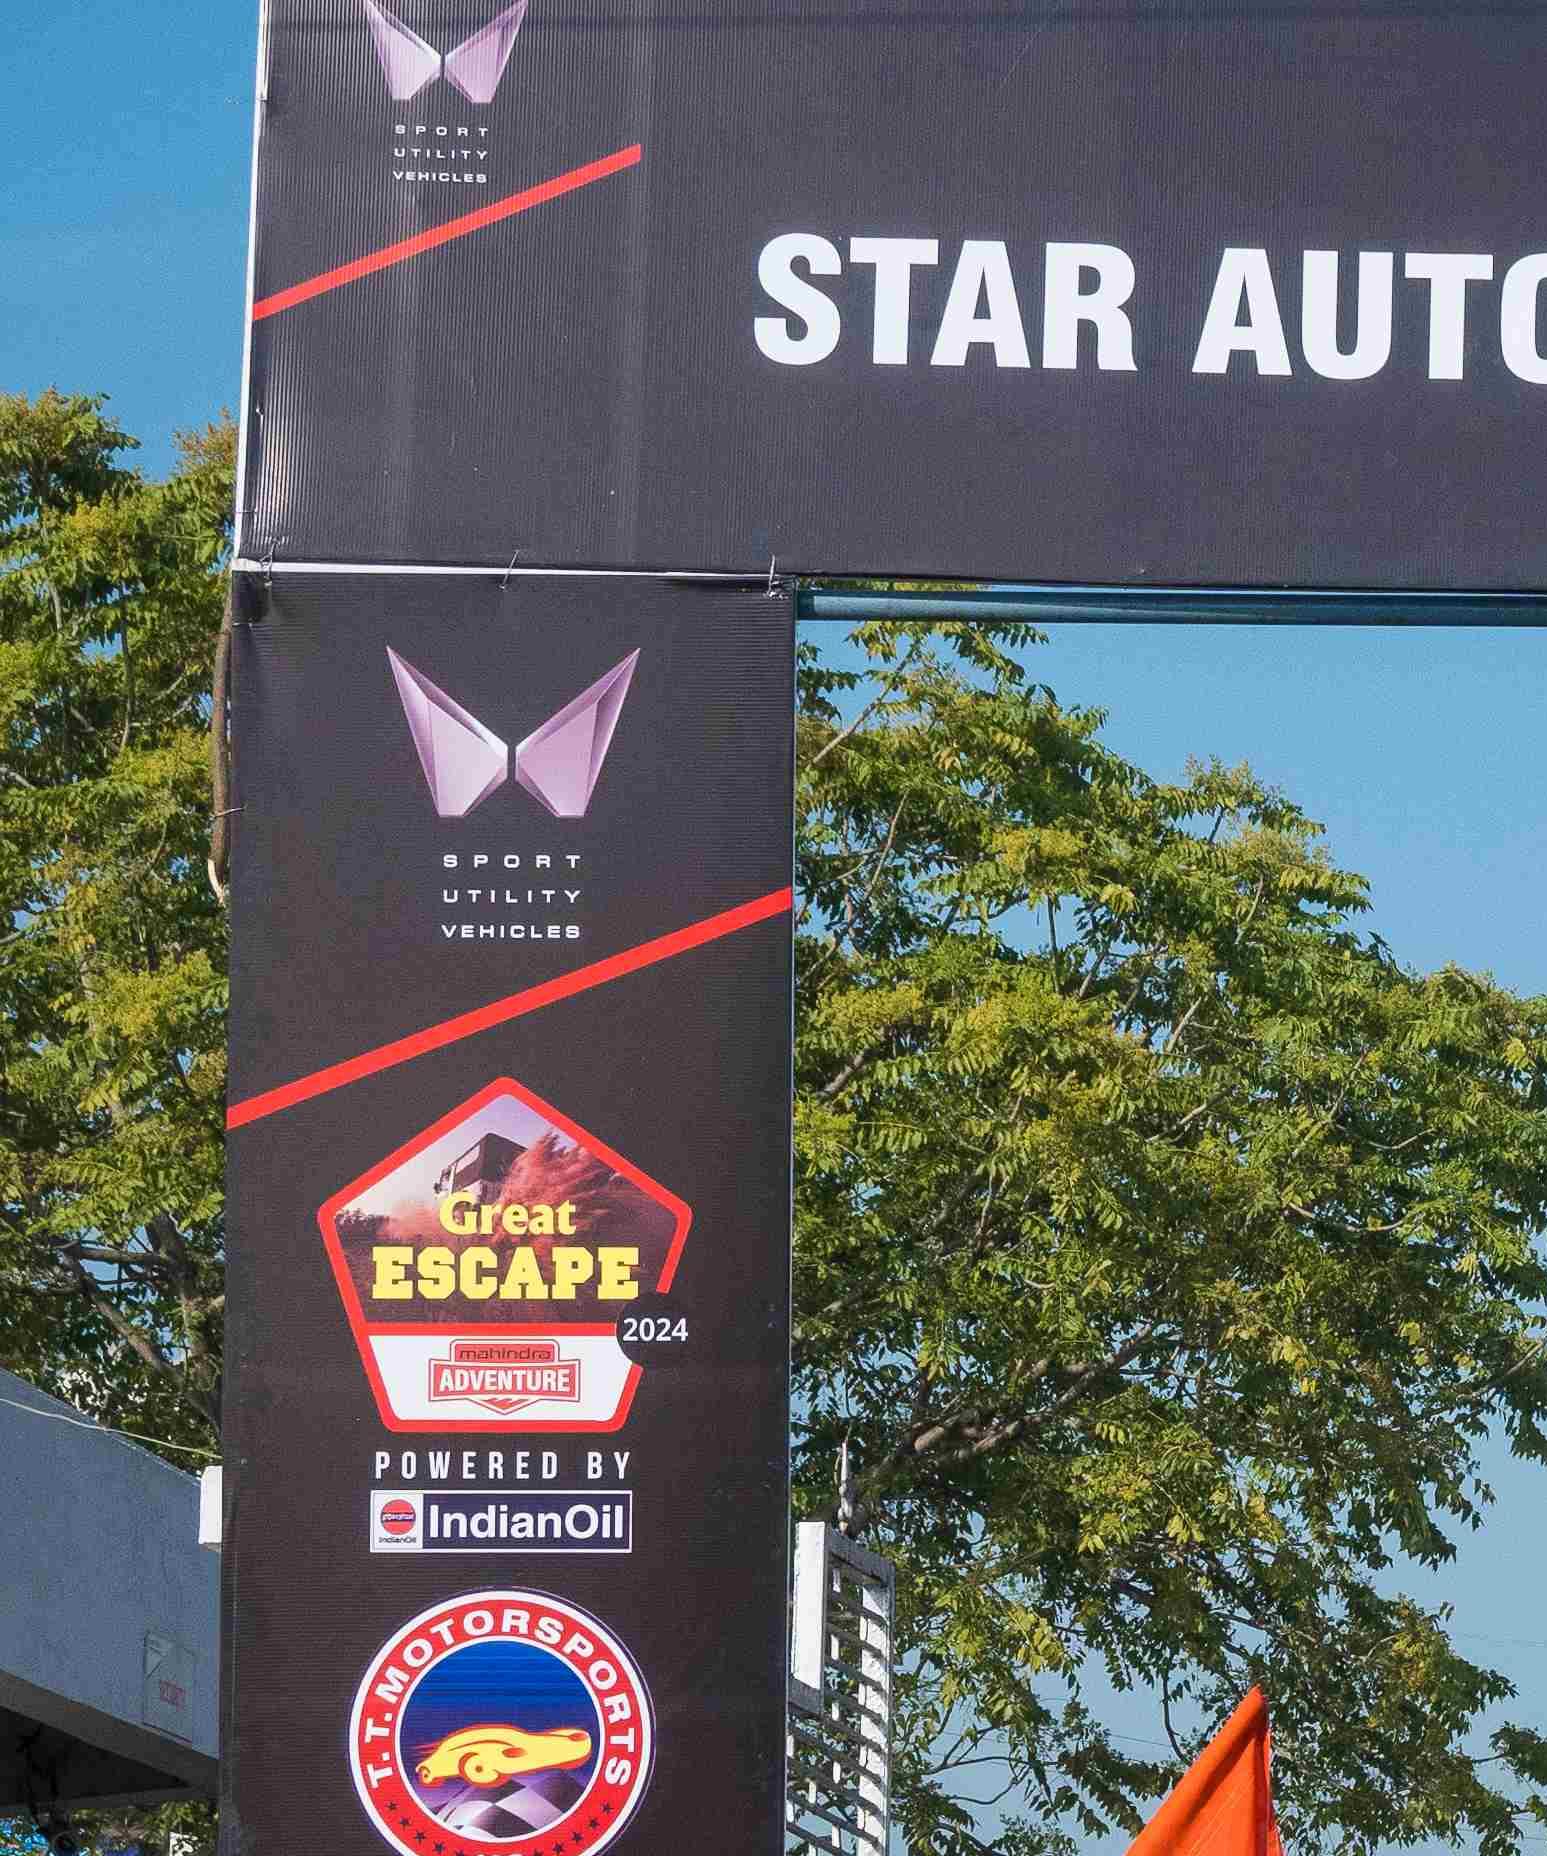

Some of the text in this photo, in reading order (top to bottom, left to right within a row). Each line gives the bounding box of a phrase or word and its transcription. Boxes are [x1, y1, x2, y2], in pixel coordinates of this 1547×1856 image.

[394, 124, 489, 137] SPORT
[394, 147, 488, 160] UTILITY
[392, 170, 488, 183] VEHICLES
[754, 233, 1137, 371] STAR
[443, 854, 581, 869] SPORT
[443, 889, 581, 904] UTILITY
[441, 924, 580, 939] VEHICLES
[439, 1192, 577, 1235] Great
[371, 1246, 640, 1300] ESCAPE
[622, 1317, 689, 1342] 2024
[458, 1346, 551, 1360] mahindra
[440, 1369, 570, 1392] ADVENTURE
[375, 1450, 630, 1480] POWERED BY
[429, 1504, 624, 1539] IndianOil
